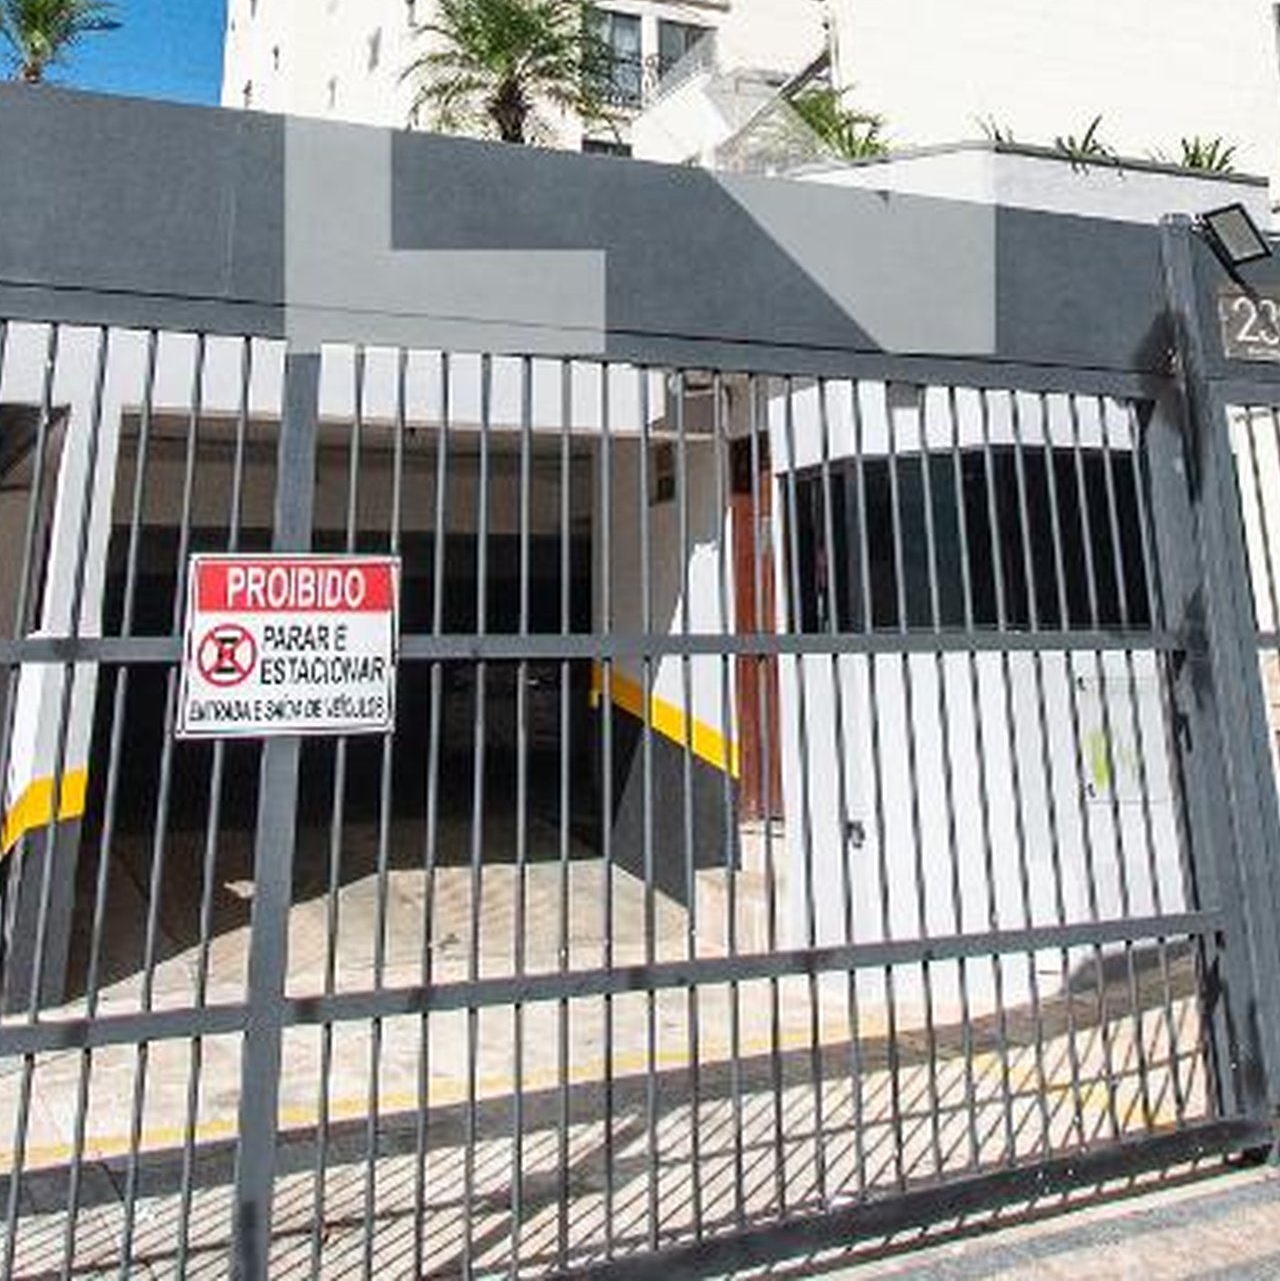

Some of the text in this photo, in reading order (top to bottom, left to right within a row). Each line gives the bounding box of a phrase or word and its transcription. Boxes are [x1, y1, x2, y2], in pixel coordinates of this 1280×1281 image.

[227, 567, 366, 608] PROIBIDO
[263, 625, 348, 652] PARAR E
[260, 657, 386, 686] ESTACIONAR
